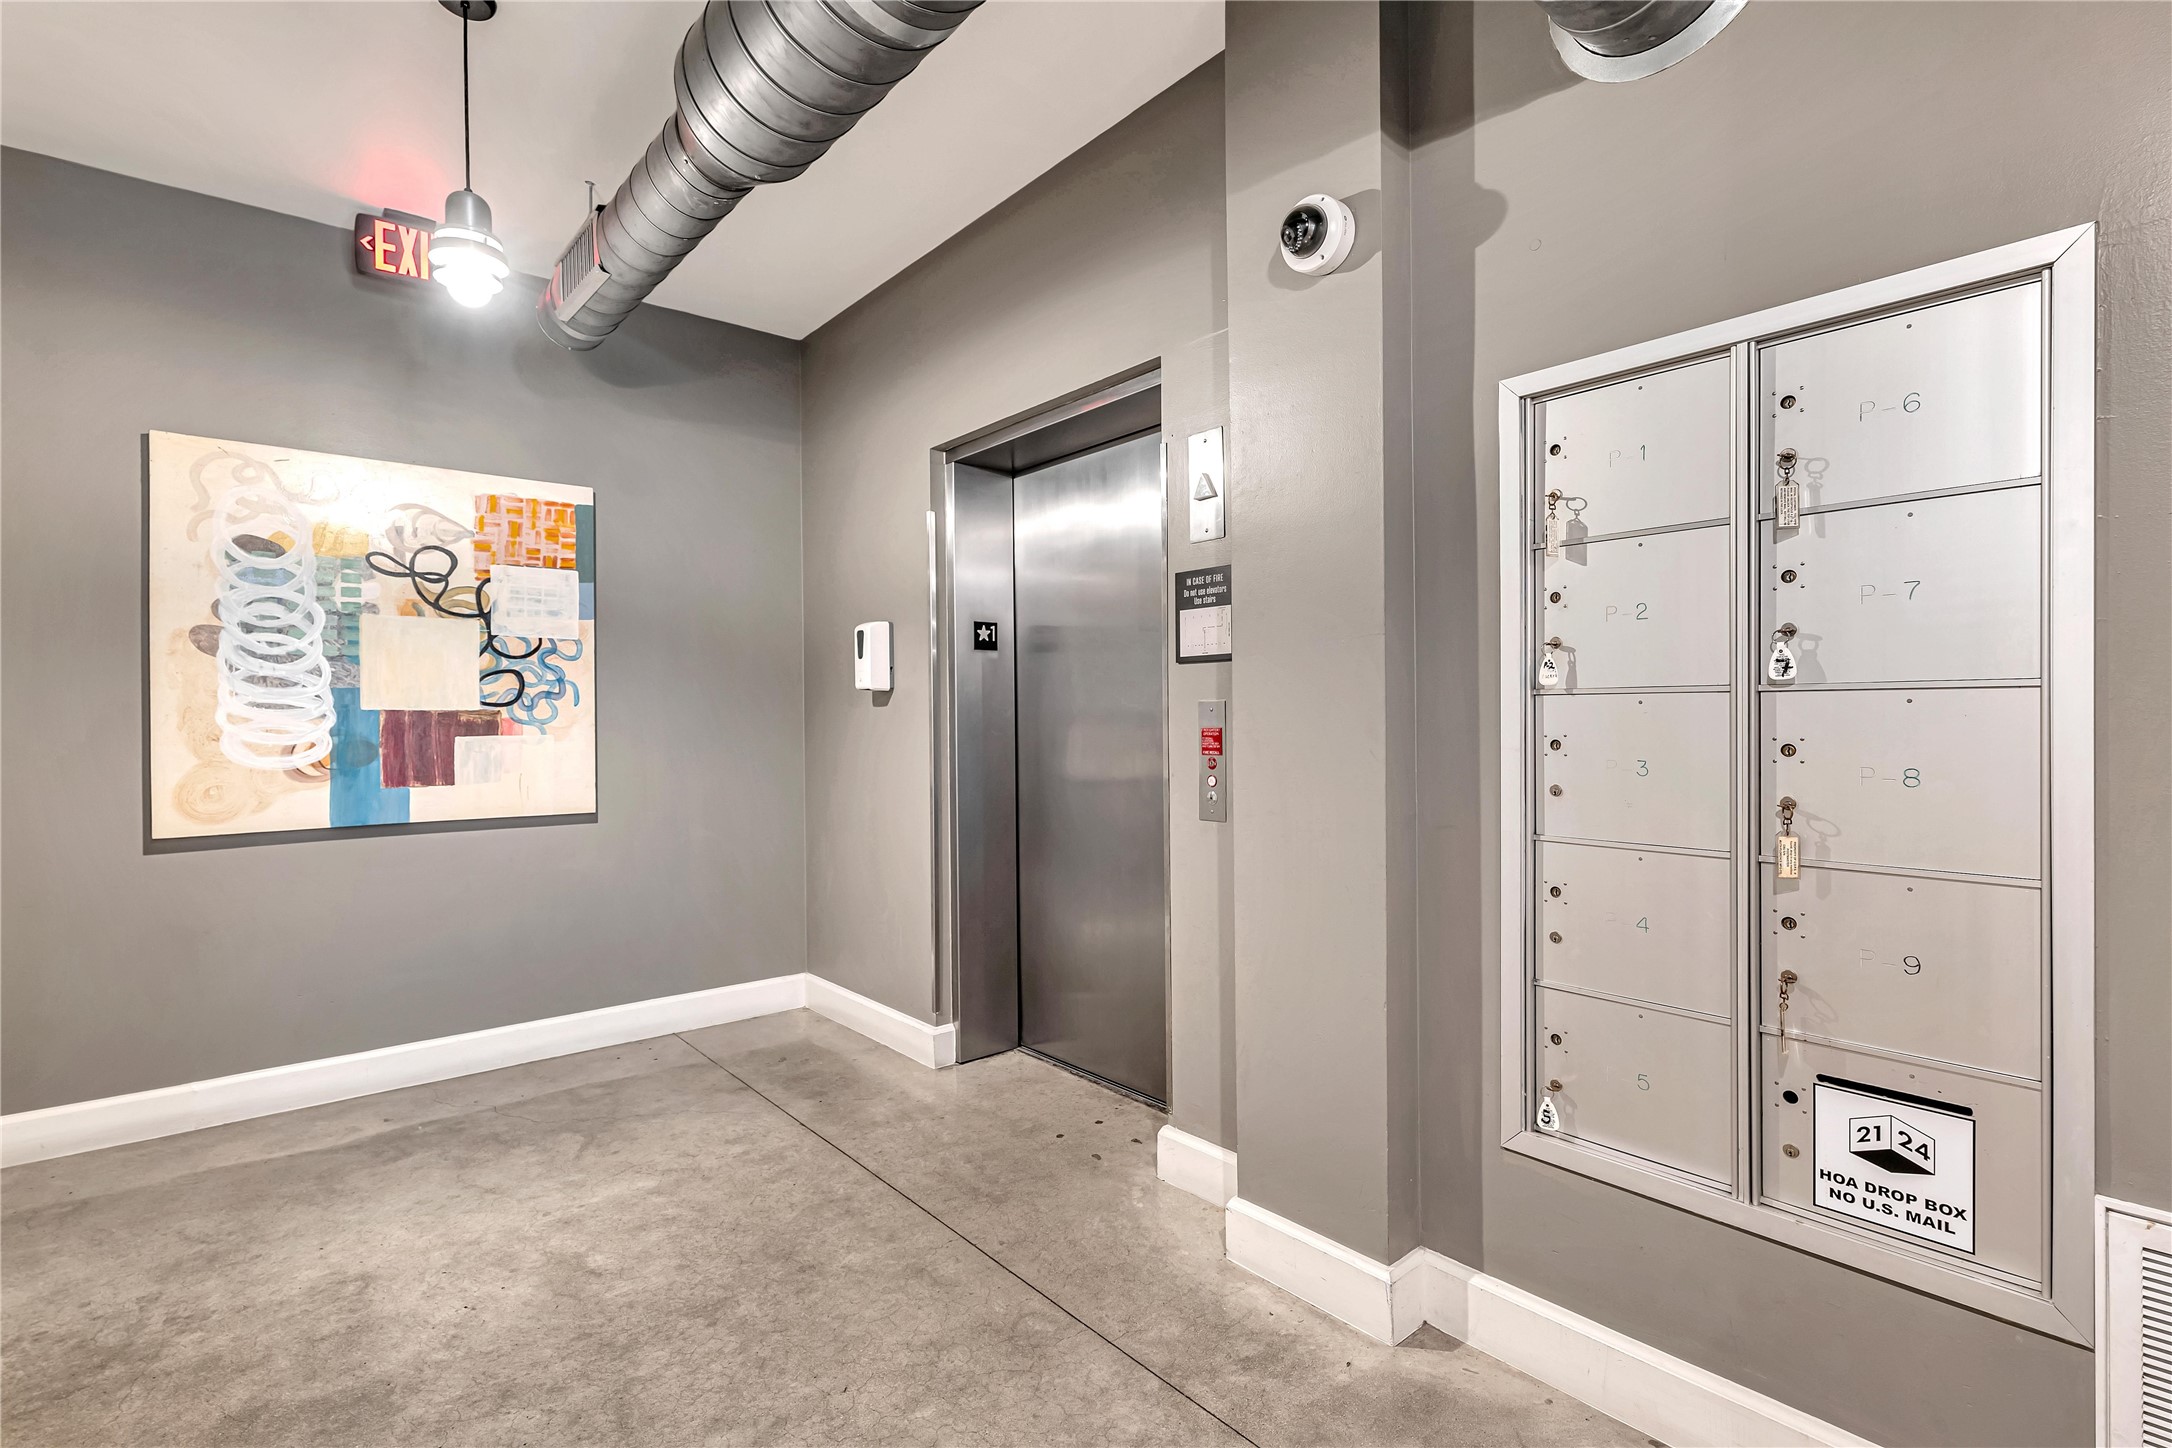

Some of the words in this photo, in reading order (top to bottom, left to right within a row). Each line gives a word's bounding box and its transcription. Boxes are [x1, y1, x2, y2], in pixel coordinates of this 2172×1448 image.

[374, 219, 432, 281] EXI
[1858, 392, 1922, 422] P-6
[1609, 444, 1648, 468] P-1
[1183, 589, 1190, 598] Do
[1190, 589, 1198, 597] not
[1198, 588, 1206, 596] use
[1206, 585, 1227, 595] elevators
[1186, 578, 1192, 586] IN
[1192, 576, 1205, 586] CASE
[1205, 574, 1212, 584] OF
[1213, 573, 1224, 583] FIRE
[1193, 597, 1202, 605] Use
[1203, 595, 1216, 604] stairs
[1859, 580, 1922, 605] P-7
[1604, 602, 1649, 622] P-2
[1859, 765, 1922, 788] P-8
[1859, 948, 1922, 976] P-9
[1856, 1125, 1882, 1143] 21
[1897, 1130, 1931, 1162] 24
[1819, 1168, 1858, 1189] HOA
[1864, 1181, 1917, 1205] DROP
[1925, 1198, 1968, 1221] BOX
[1829, 1187, 1856, 1204] NO
[1862, 1197, 1899, 1217] U.S.
[1906, 1210, 1957, 1235] MAIL
